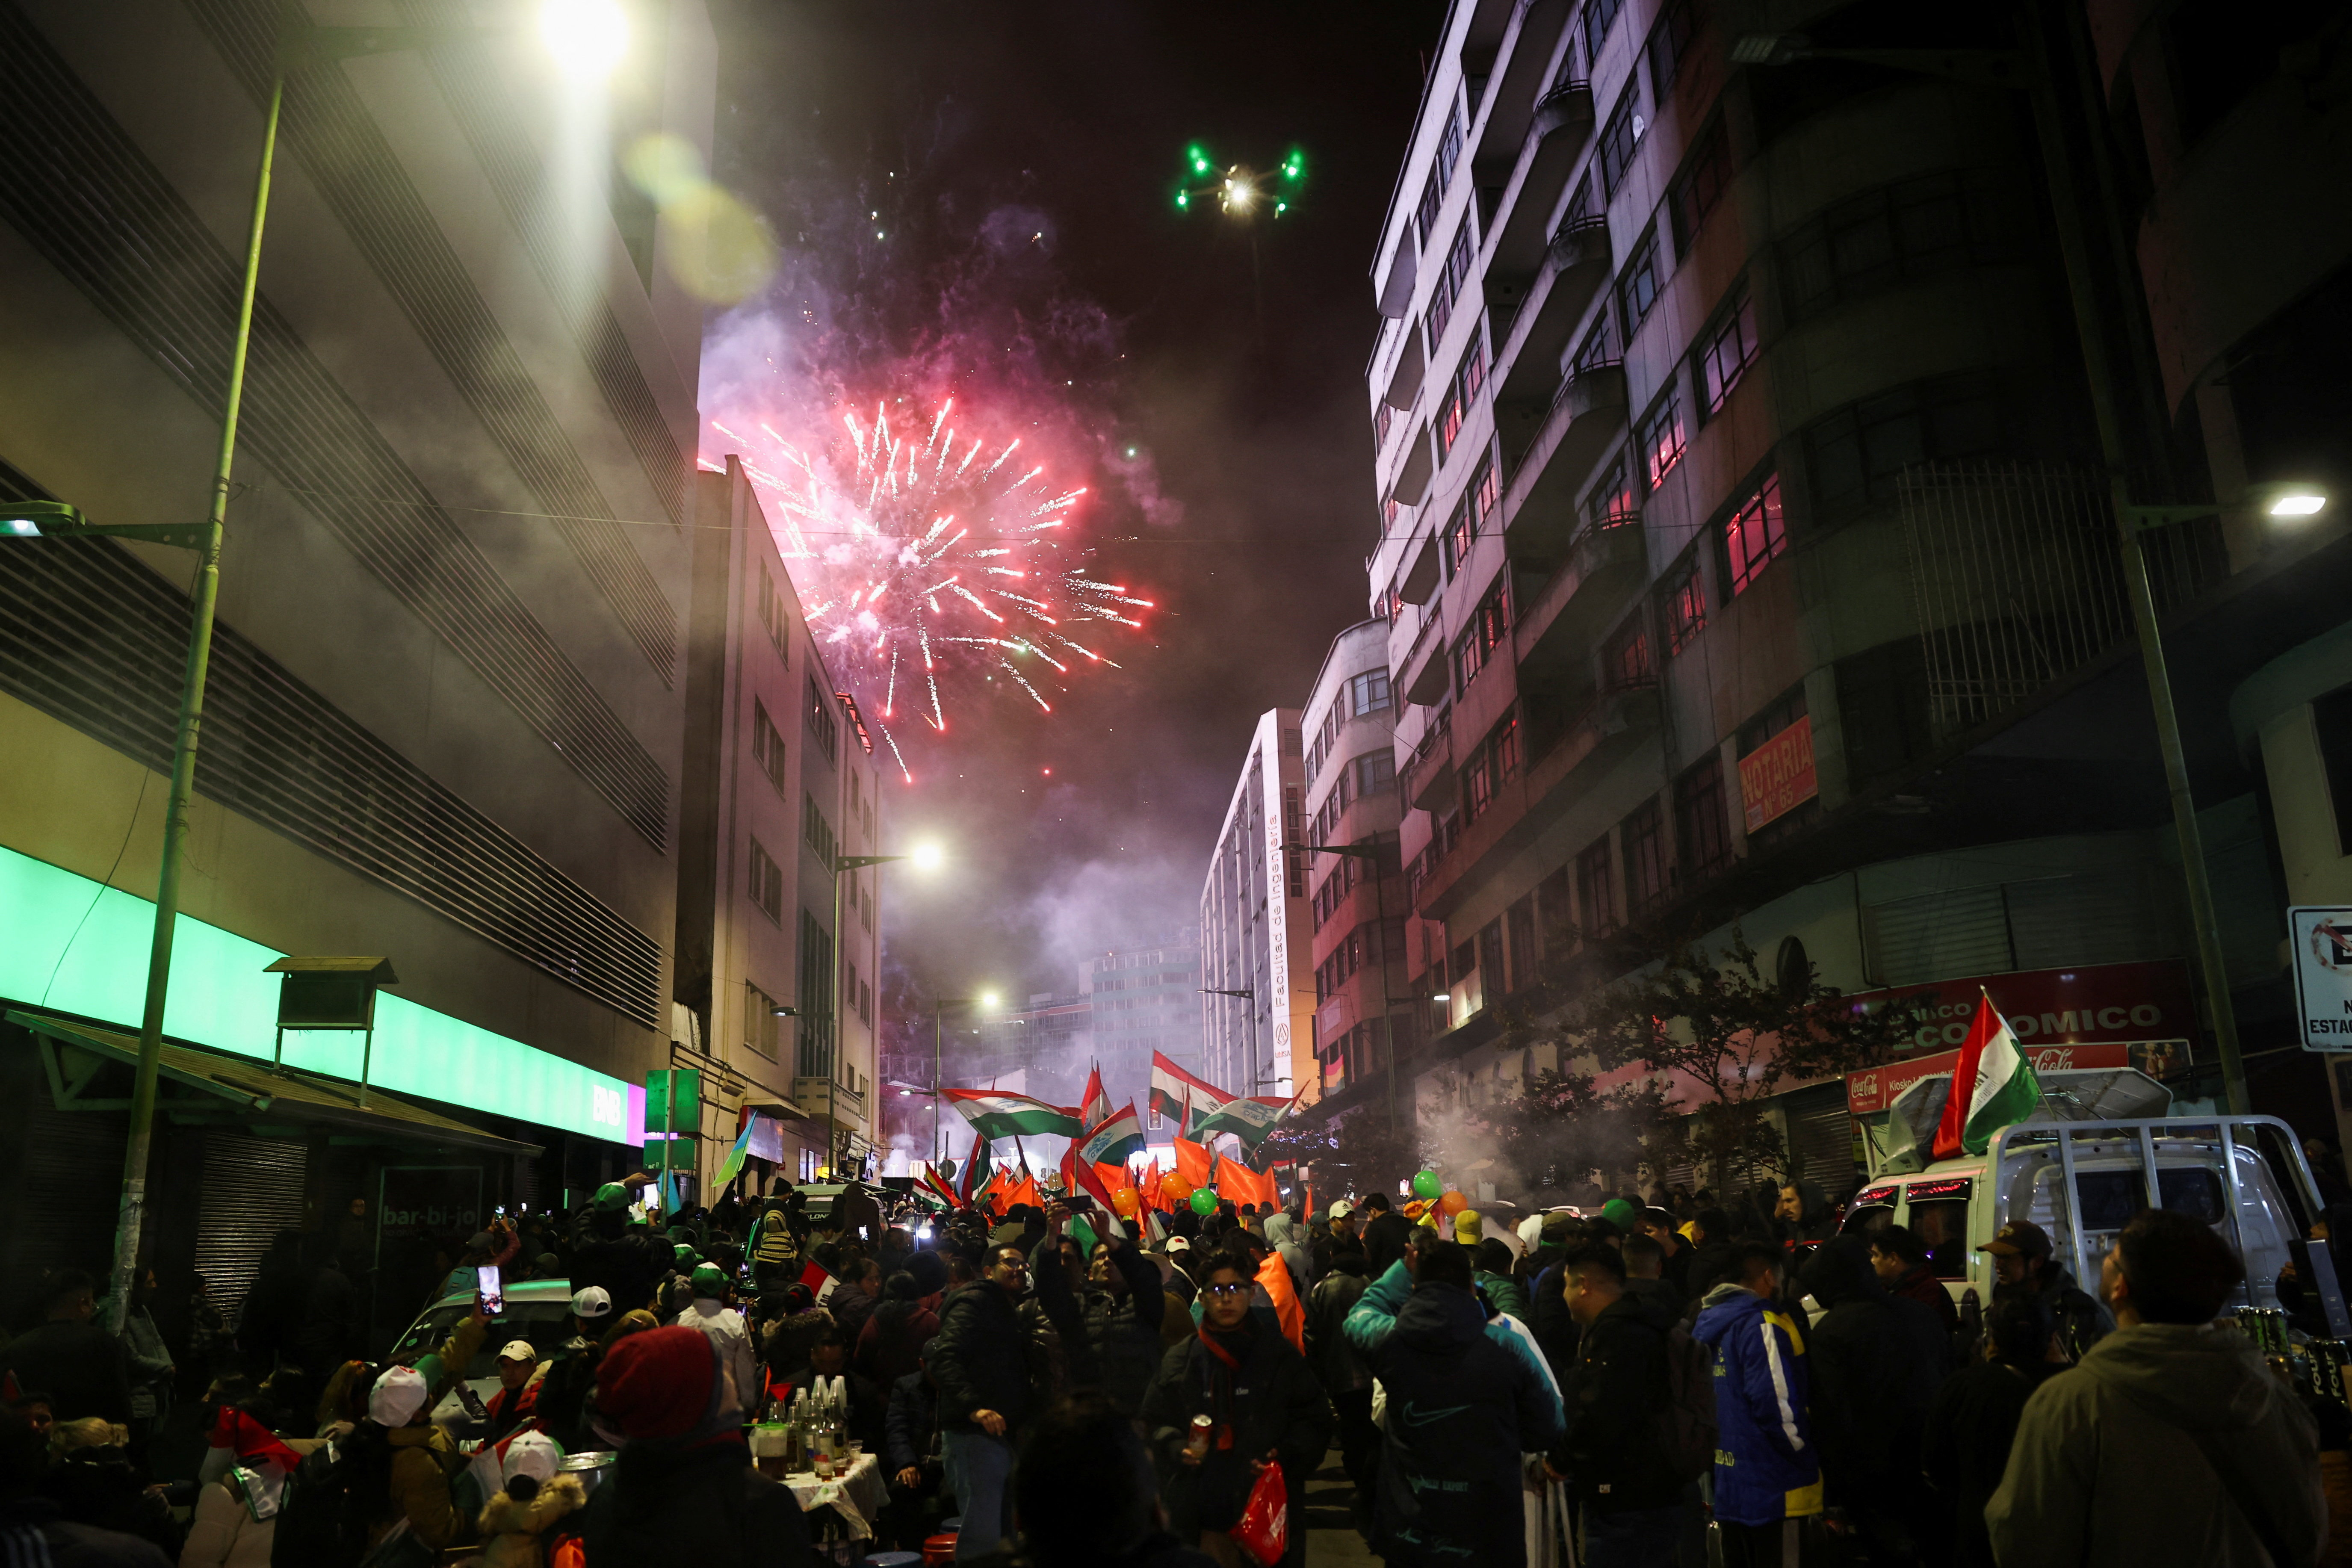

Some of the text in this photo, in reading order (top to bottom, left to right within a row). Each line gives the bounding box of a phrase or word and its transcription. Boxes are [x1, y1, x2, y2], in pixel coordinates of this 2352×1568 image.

[1742, 729, 1813, 807] NOTARIA
[1780, 784, 1793, 809] 65
[1272, 905, 1281, 926] de
[1273, 933, 1285, 1007] Facultad
[1889, 1078, 1913, 1091] Kiosko
[593, 1084, 621, 1126] BNB
